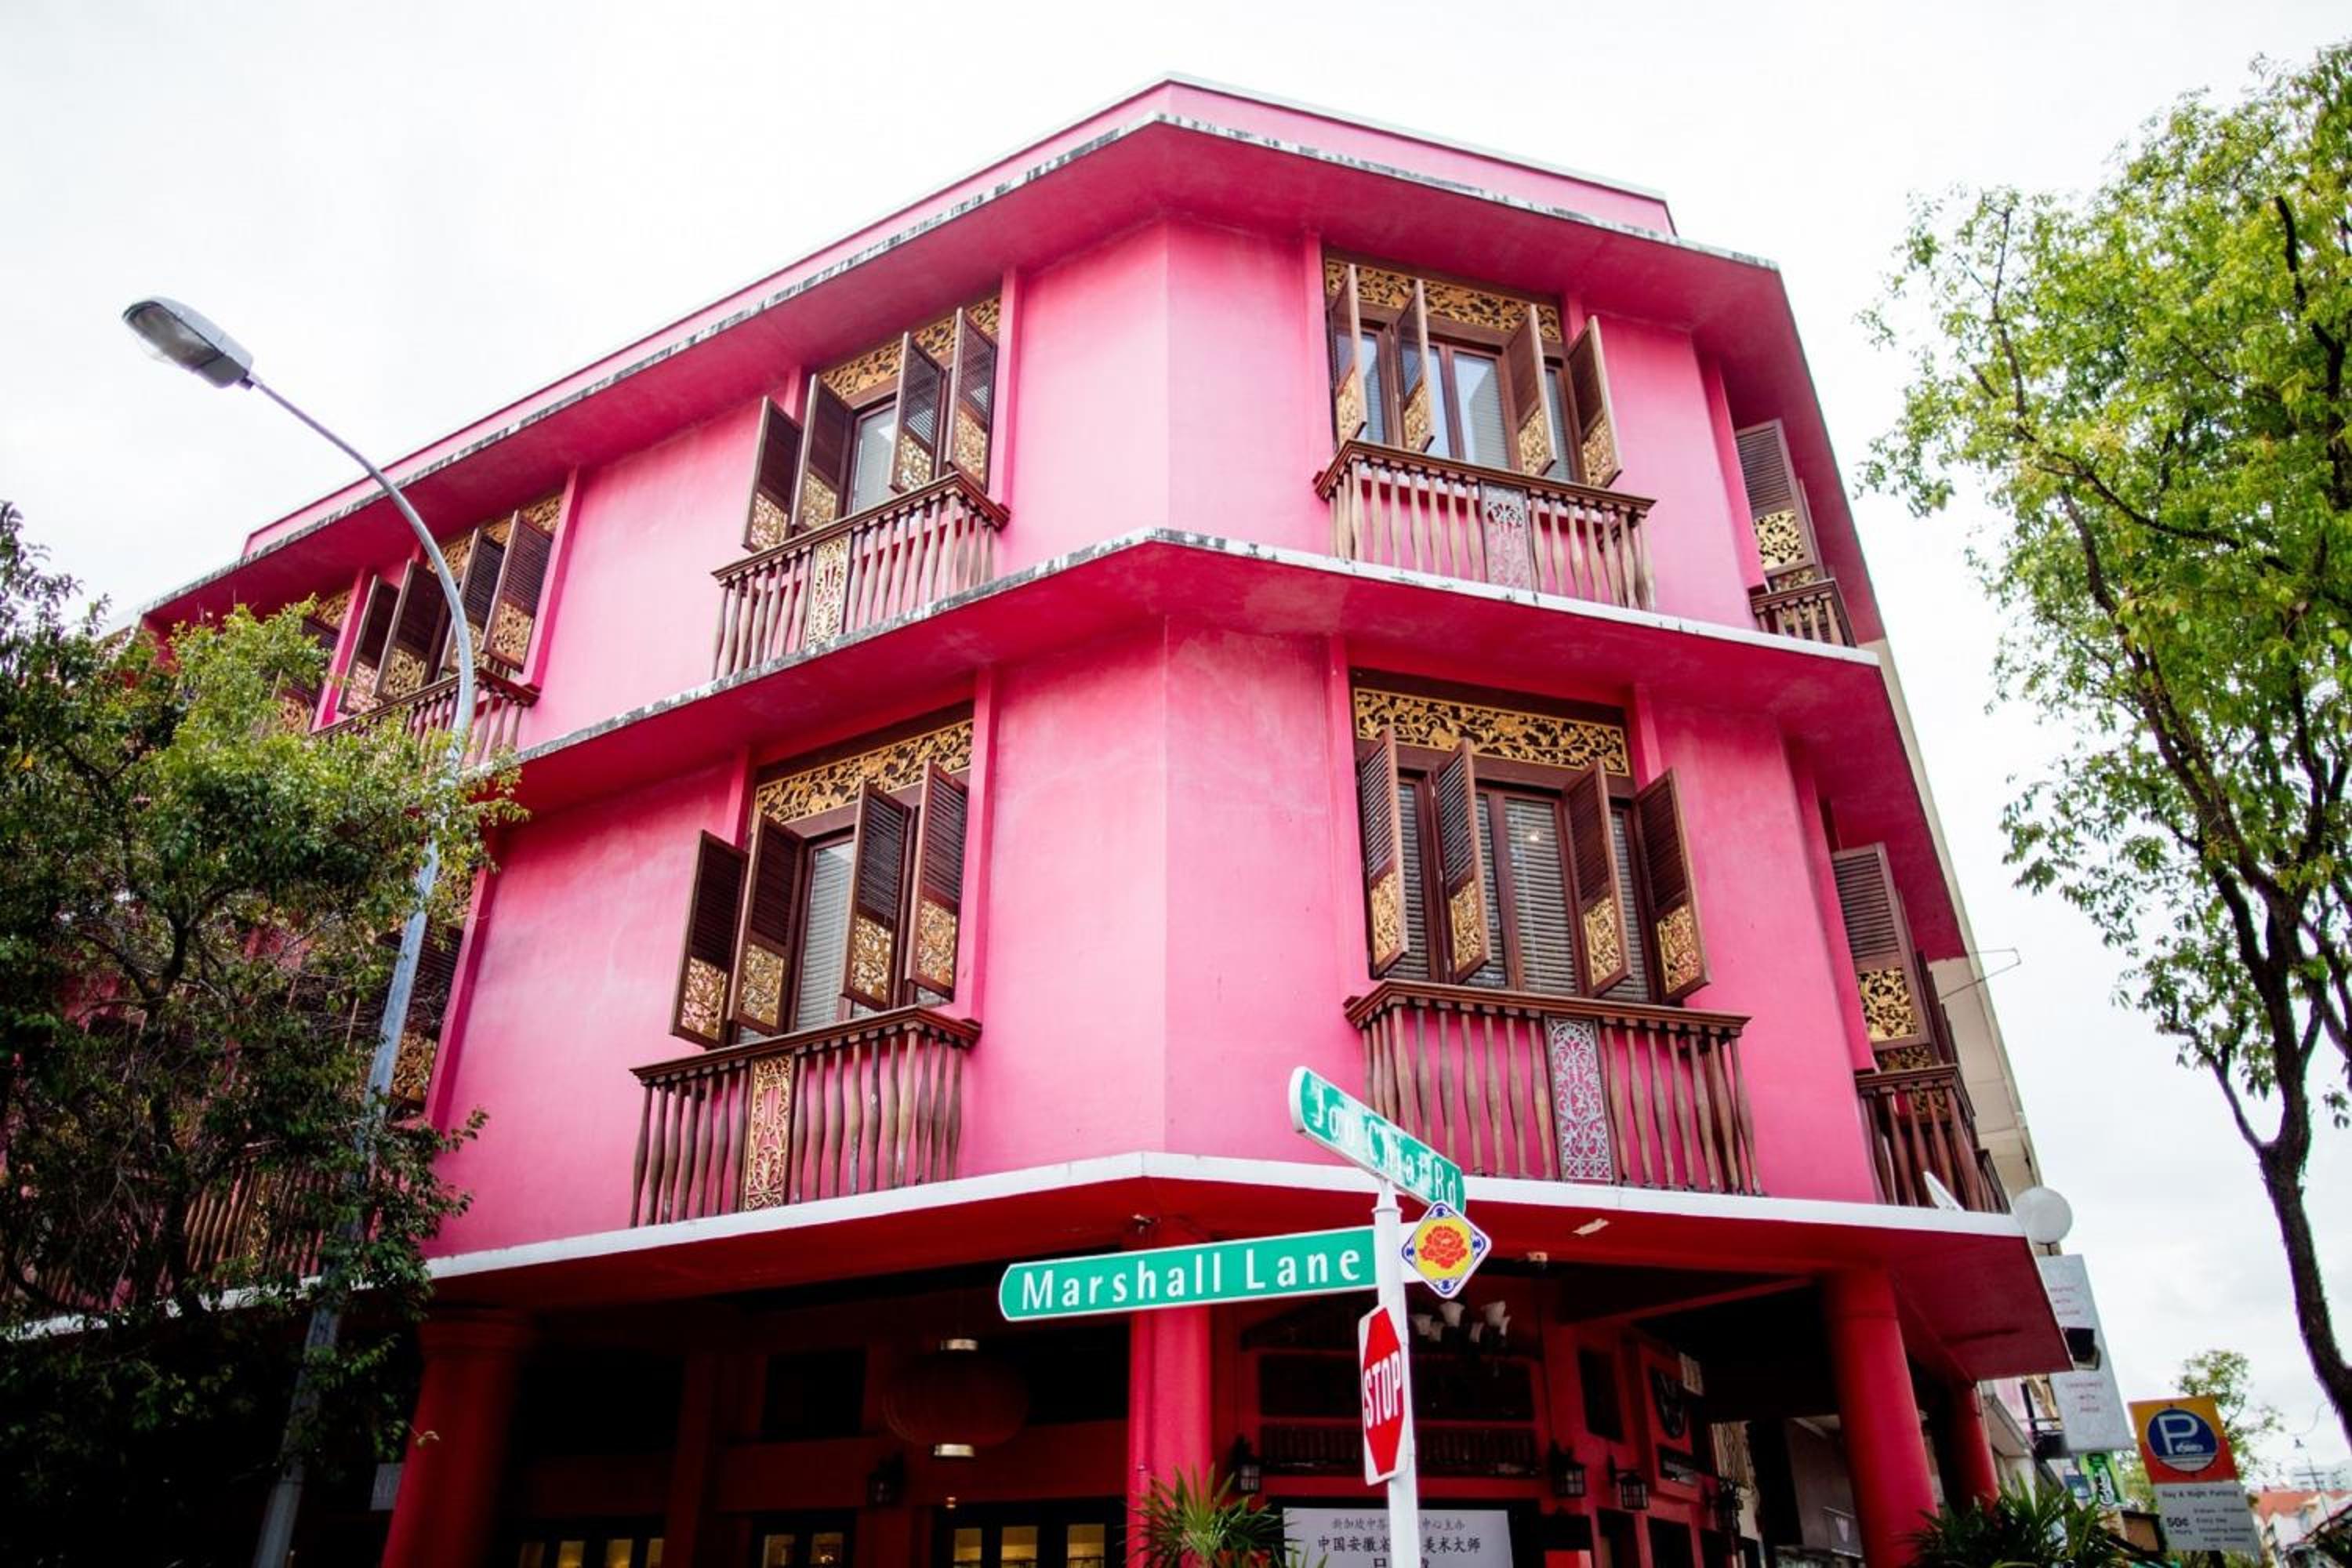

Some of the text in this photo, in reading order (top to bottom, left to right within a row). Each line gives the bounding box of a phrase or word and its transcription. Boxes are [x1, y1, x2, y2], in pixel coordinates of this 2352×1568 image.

[1434, 1159, 1457, 1204] Rd
[1022, 1249, 1361, 1311] Marshall Lane
[1364, 1350, 1402, 1429] STOP
[2157, 1414, 2198, 1454] P
